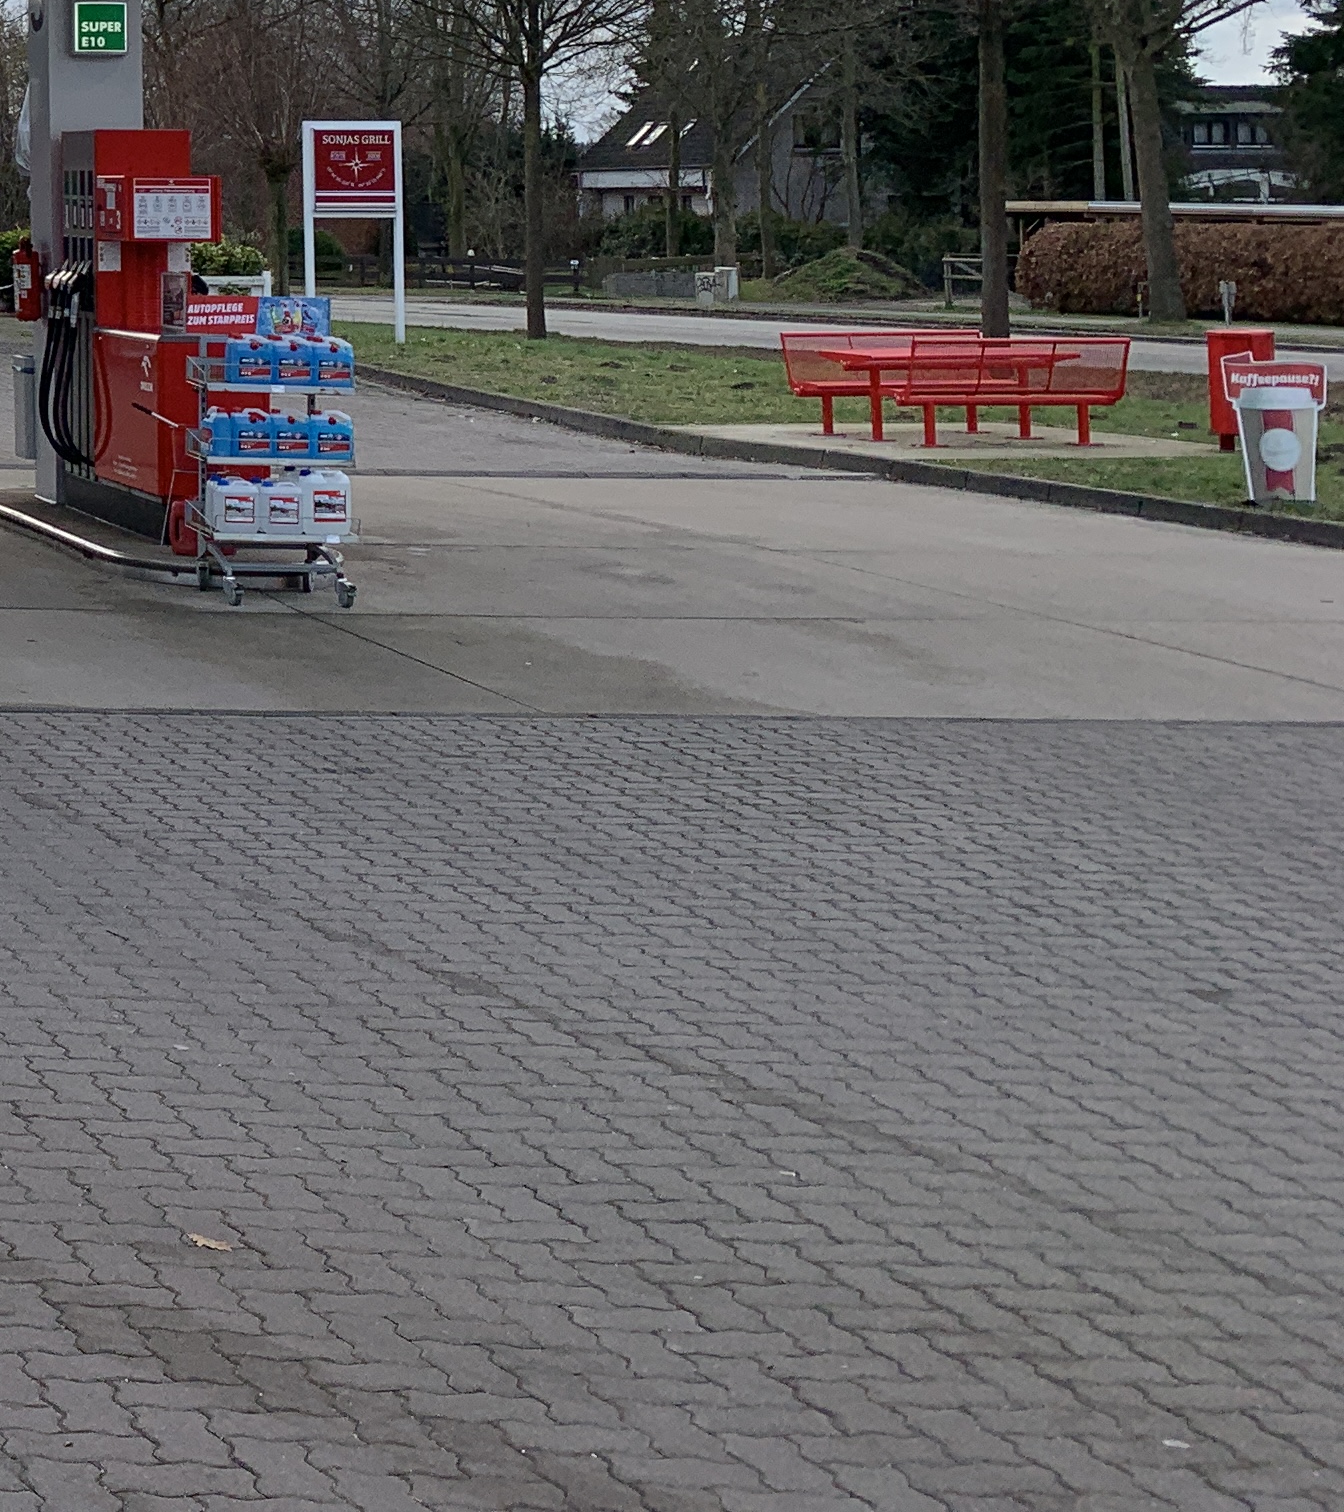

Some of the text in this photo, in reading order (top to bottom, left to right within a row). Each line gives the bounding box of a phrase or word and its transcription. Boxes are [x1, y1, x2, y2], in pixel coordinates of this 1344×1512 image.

[81, 21, 122, 33] SUPER
[81, 36, 105, 47] E10
[322, 134, 391, 145] SONJAS GRILL
[187, 302, 243, 314] AUTOPFLEGE
[187, 314, 255, 325] ZUM STARPREIS
